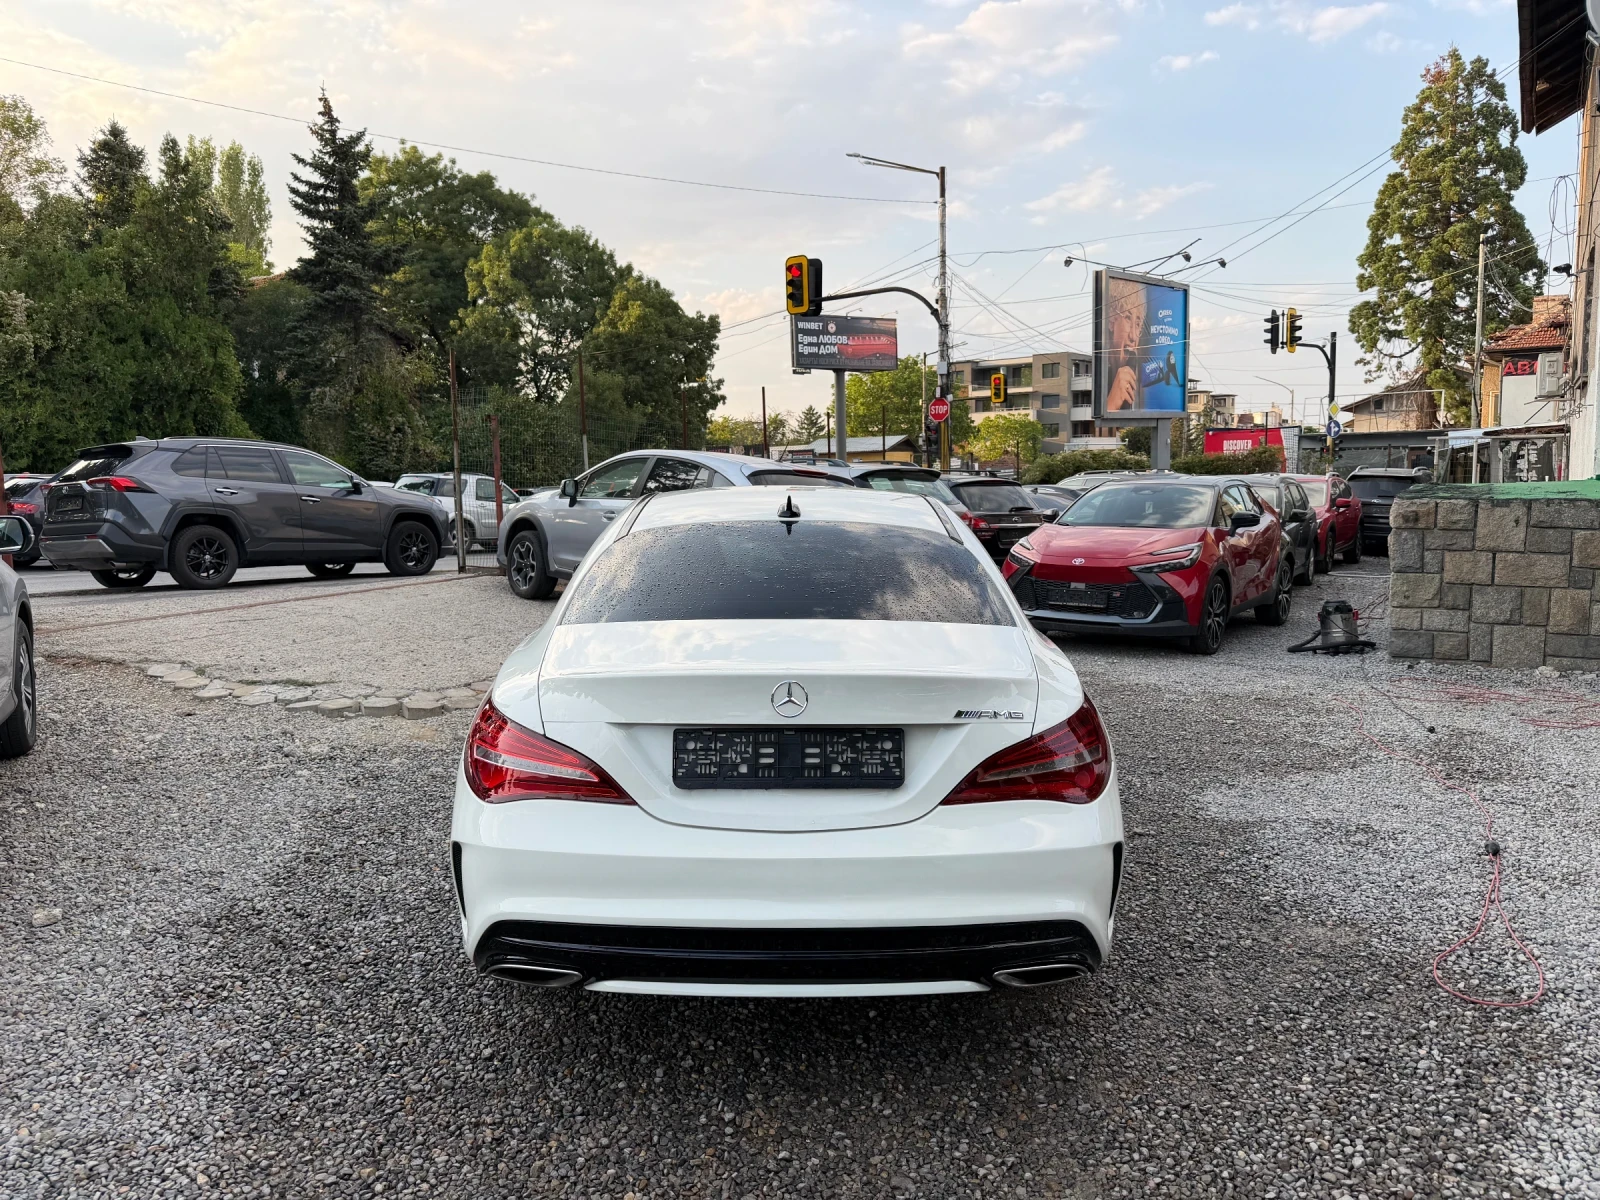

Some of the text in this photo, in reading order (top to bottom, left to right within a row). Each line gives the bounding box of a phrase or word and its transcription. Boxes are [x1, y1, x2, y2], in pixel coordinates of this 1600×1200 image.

[797, 322, 823, 330] WINBET
[818, 336, 848, 344] ЛЮБОВ
[819, 346, 838, 354] ДОМ
[930, 405, 947, 414] STOP
[1223, 440, 1252, 450] DISCOVER
